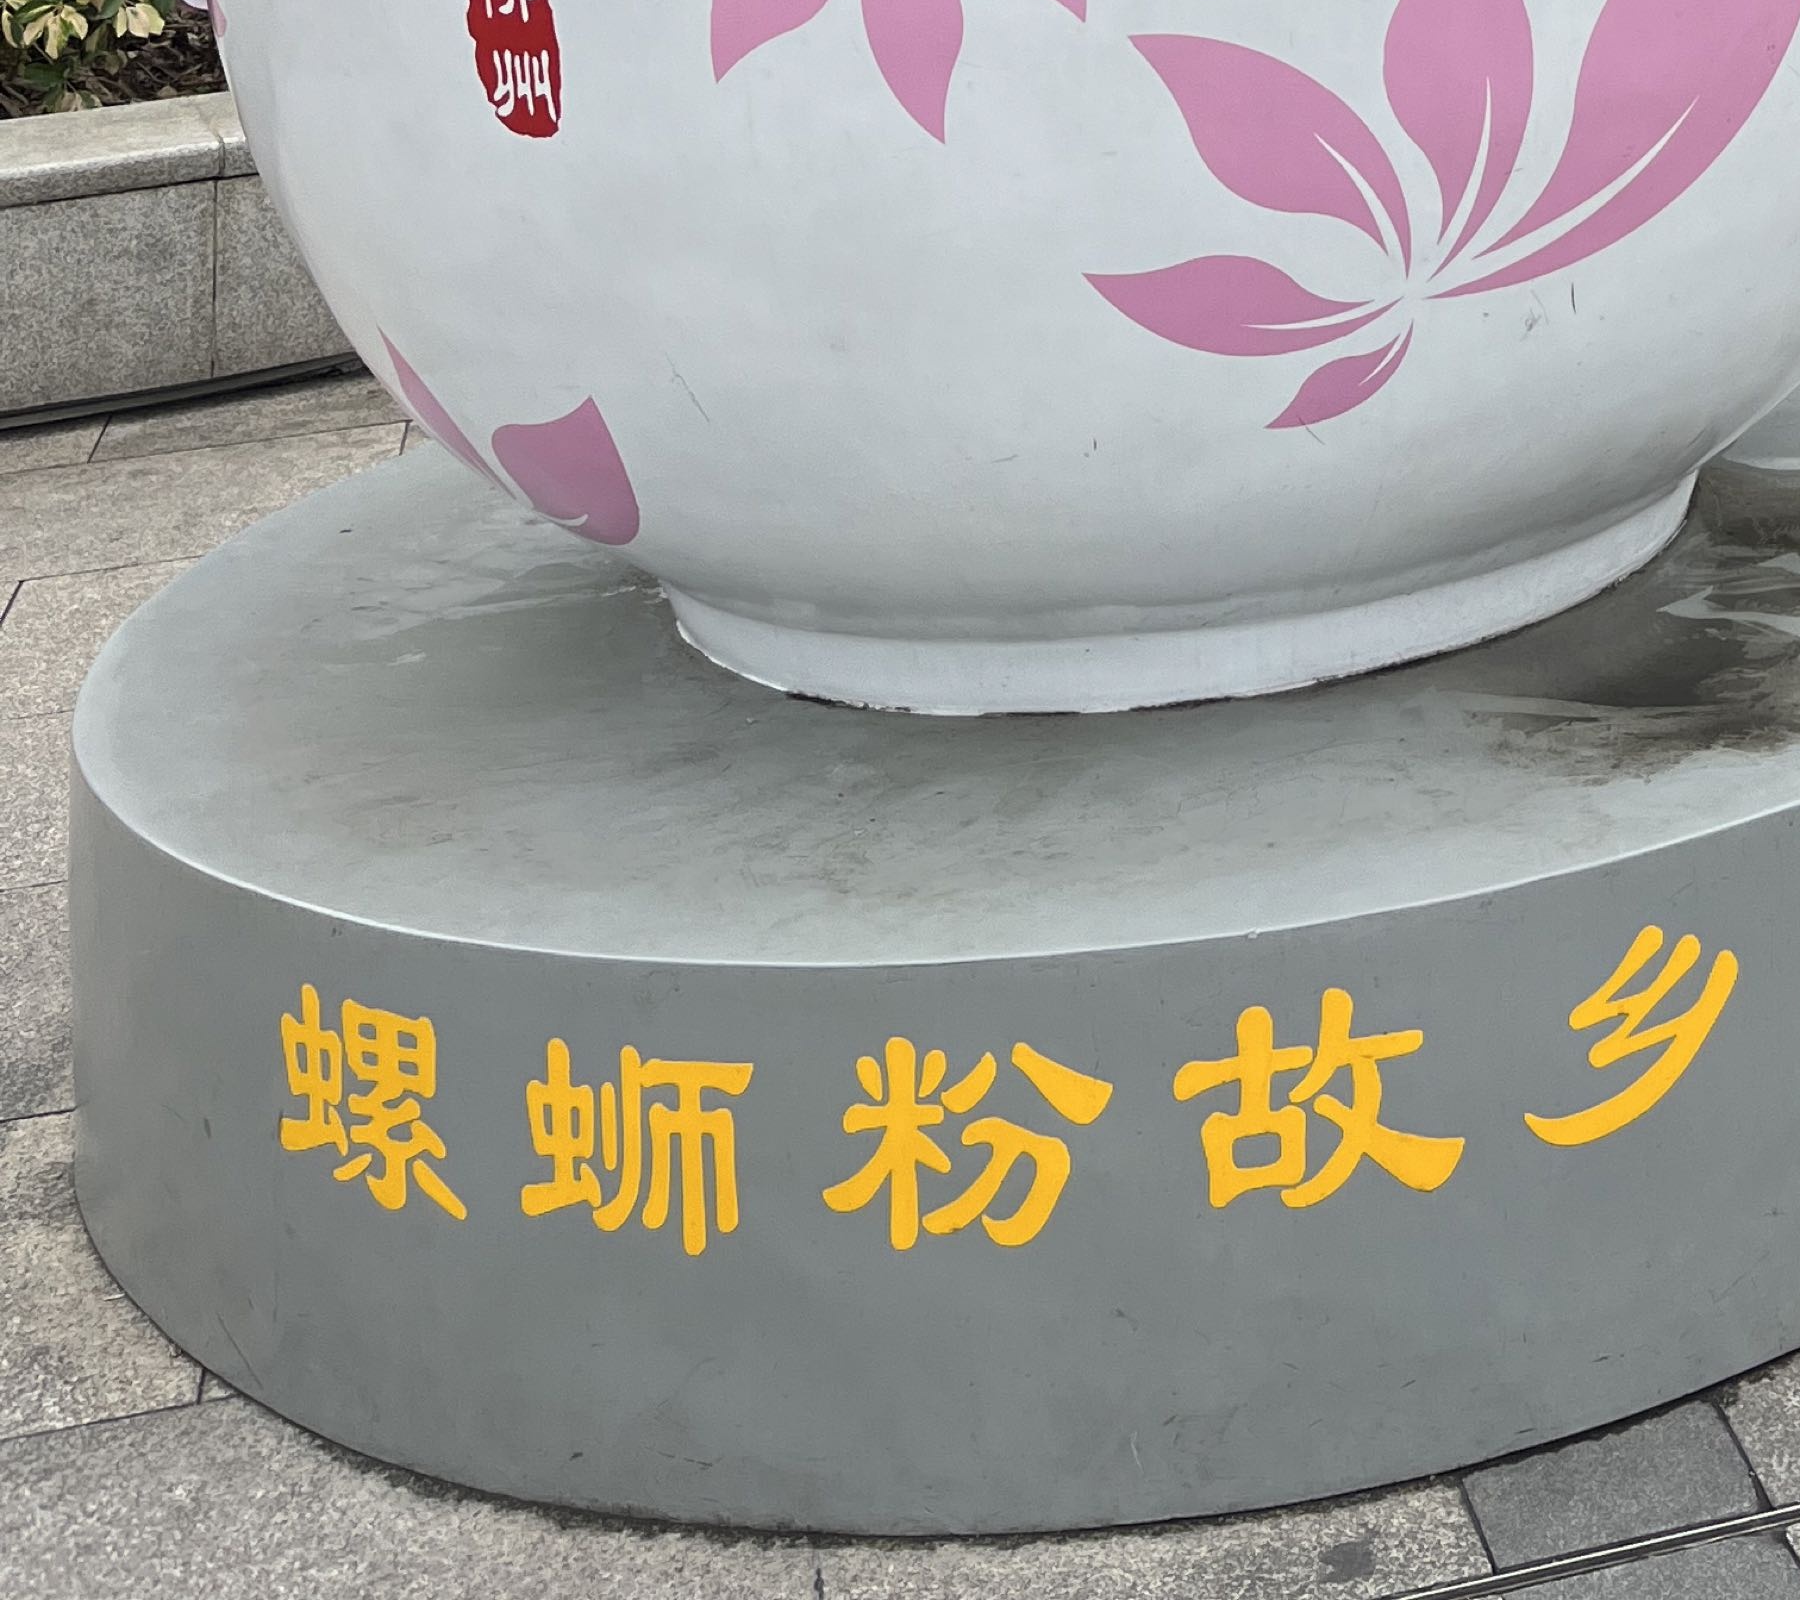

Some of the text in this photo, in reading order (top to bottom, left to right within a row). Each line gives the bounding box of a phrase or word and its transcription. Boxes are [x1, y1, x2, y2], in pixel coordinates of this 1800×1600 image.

[279, 925, 1738, 1255] 螺蛳粉故乡
